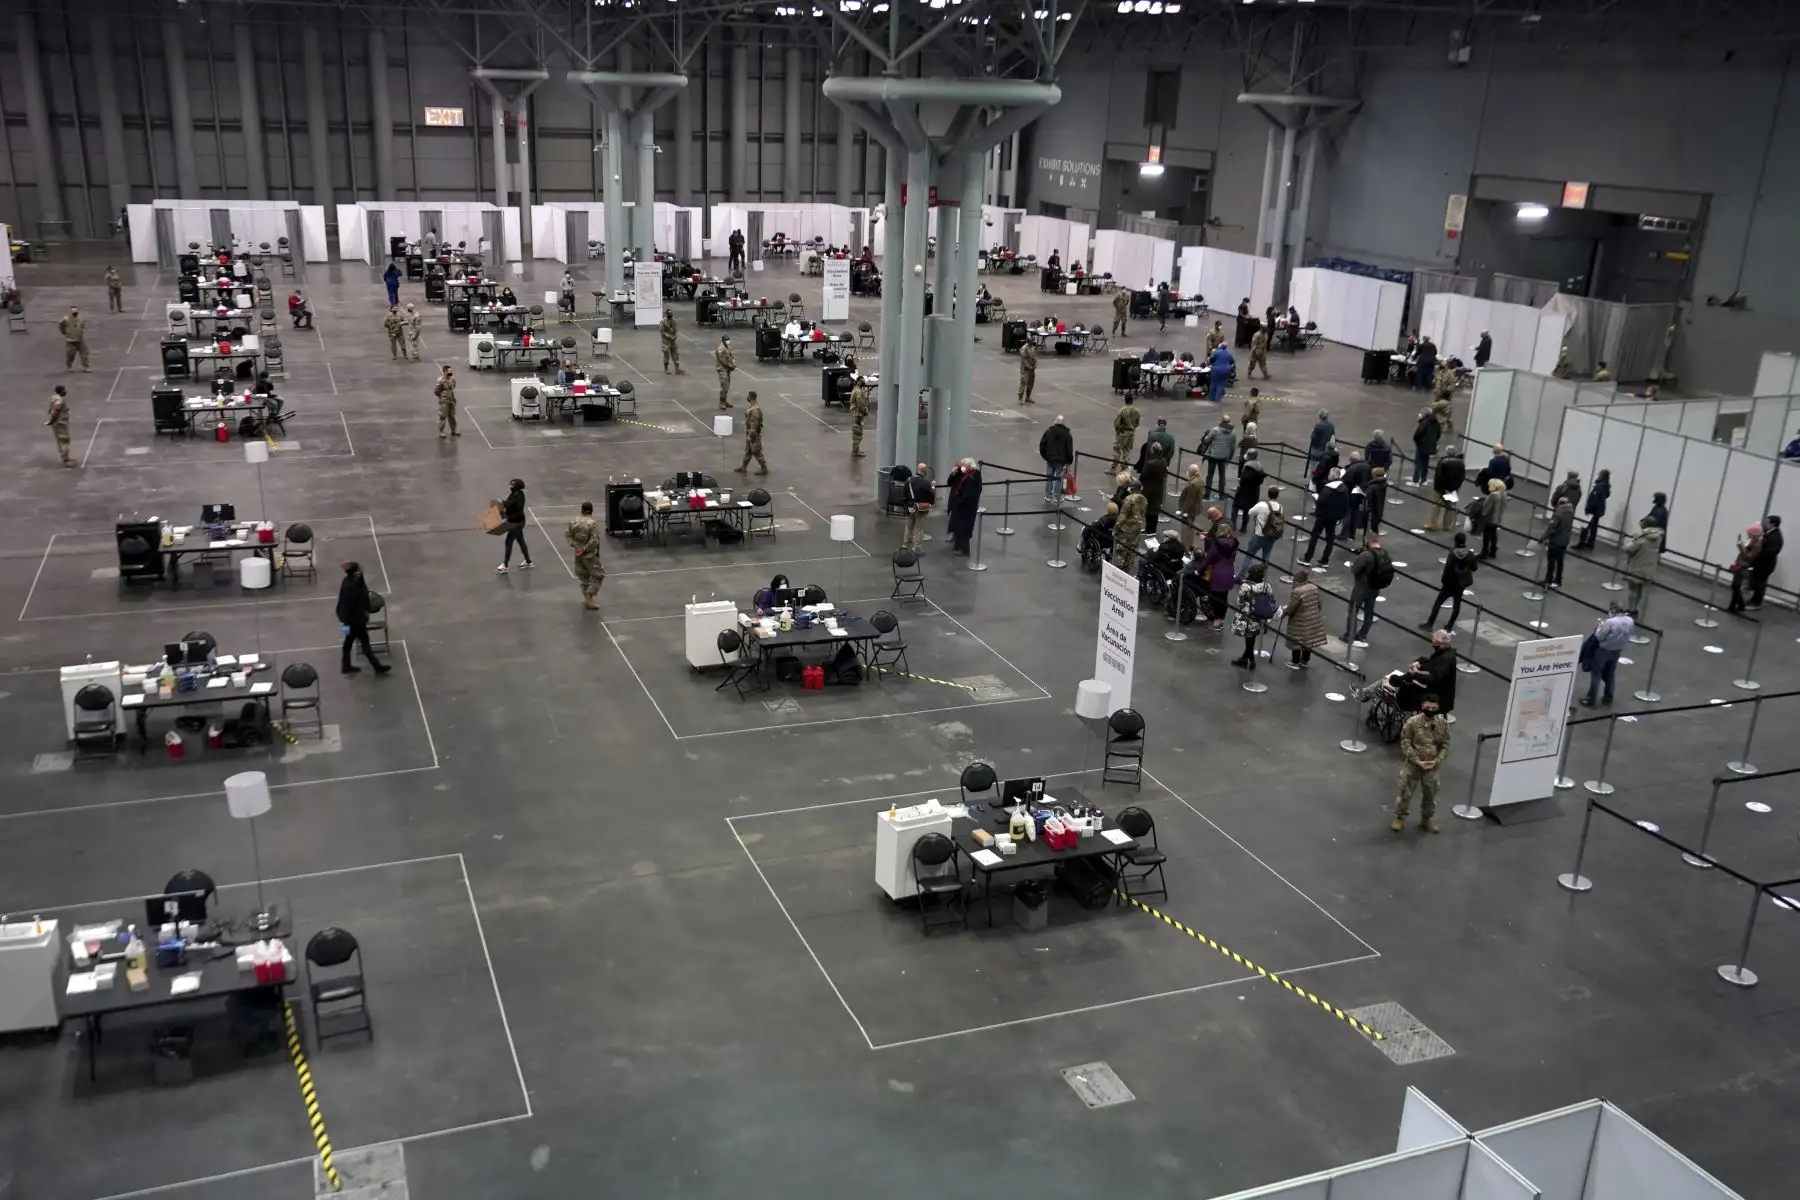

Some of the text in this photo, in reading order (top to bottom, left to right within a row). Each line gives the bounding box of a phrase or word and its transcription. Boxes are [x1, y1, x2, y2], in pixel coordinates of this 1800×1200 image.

[427, 108, 462, 124] EXIT
[1038, 157, 1101, 176] EXHIBIT SOLUTIONS
[1103, 587, 1134, 613] Vaccination
[1111, 604, 1124, 618] Area
[1101, 629, 1131, 657] Vacunación
[1119, 632, 1127, 643] de
[1520, 661, 1573, 673] You Are Here:
